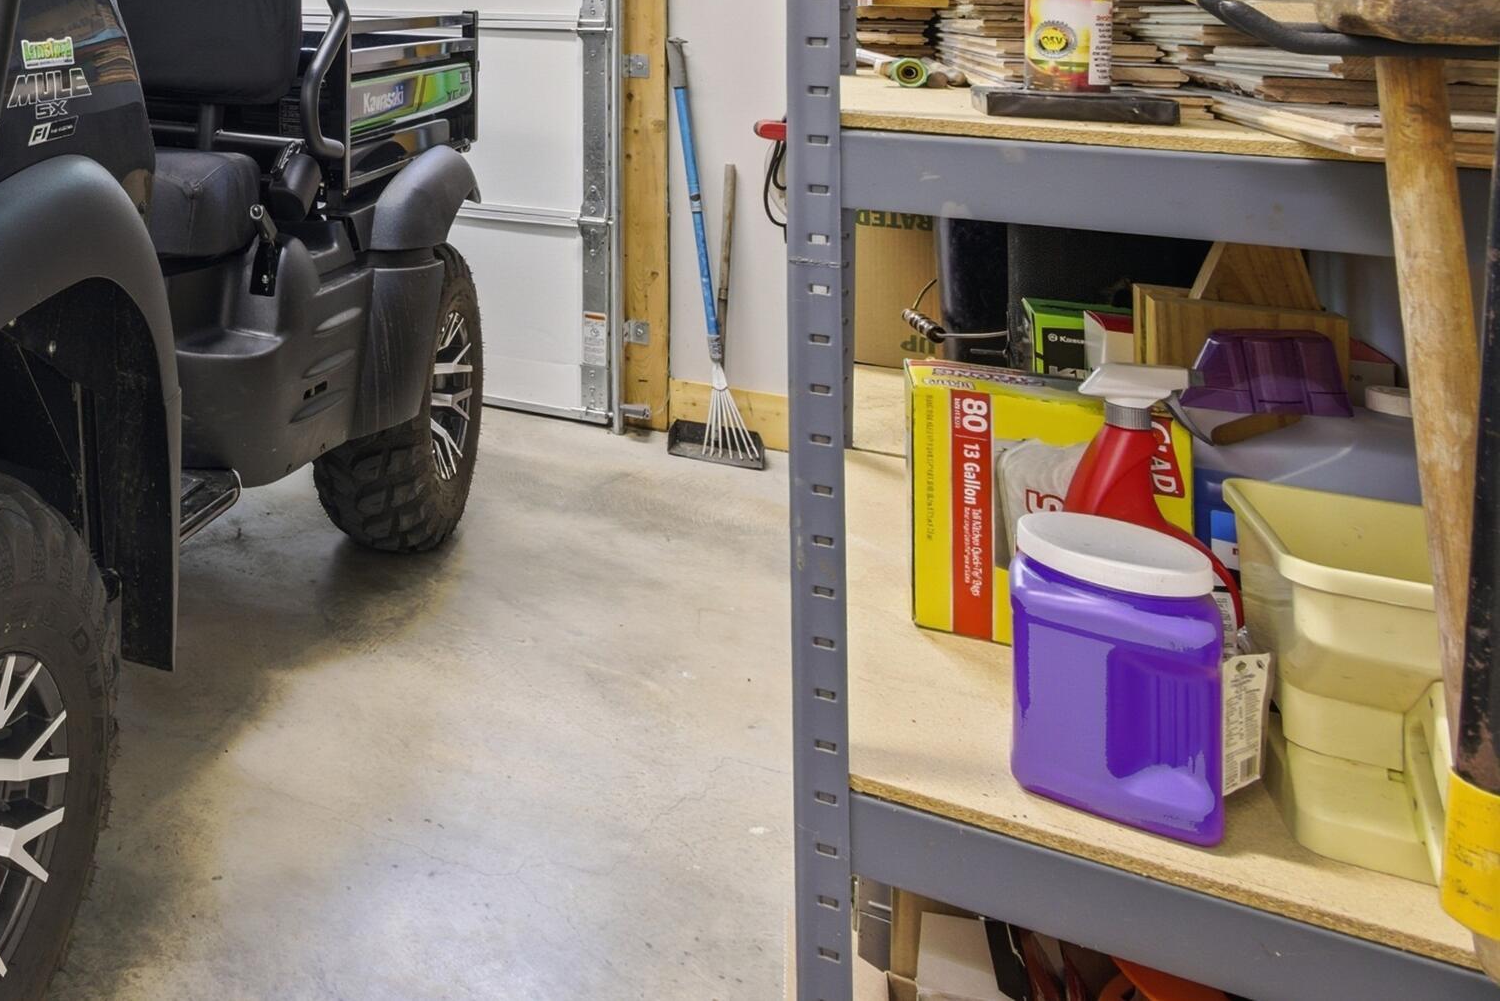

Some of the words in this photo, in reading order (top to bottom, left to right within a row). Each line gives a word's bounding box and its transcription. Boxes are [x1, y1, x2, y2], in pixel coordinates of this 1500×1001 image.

[6, 67, 92, 109] MULE
[363, 84, 405, 115] Kawasaki
[35, 100, 68, 120] SX
[962, 397, 988, 433] 80
[963, 443, 980, 459] 13
[963, 463, 981, 505] Gallon
